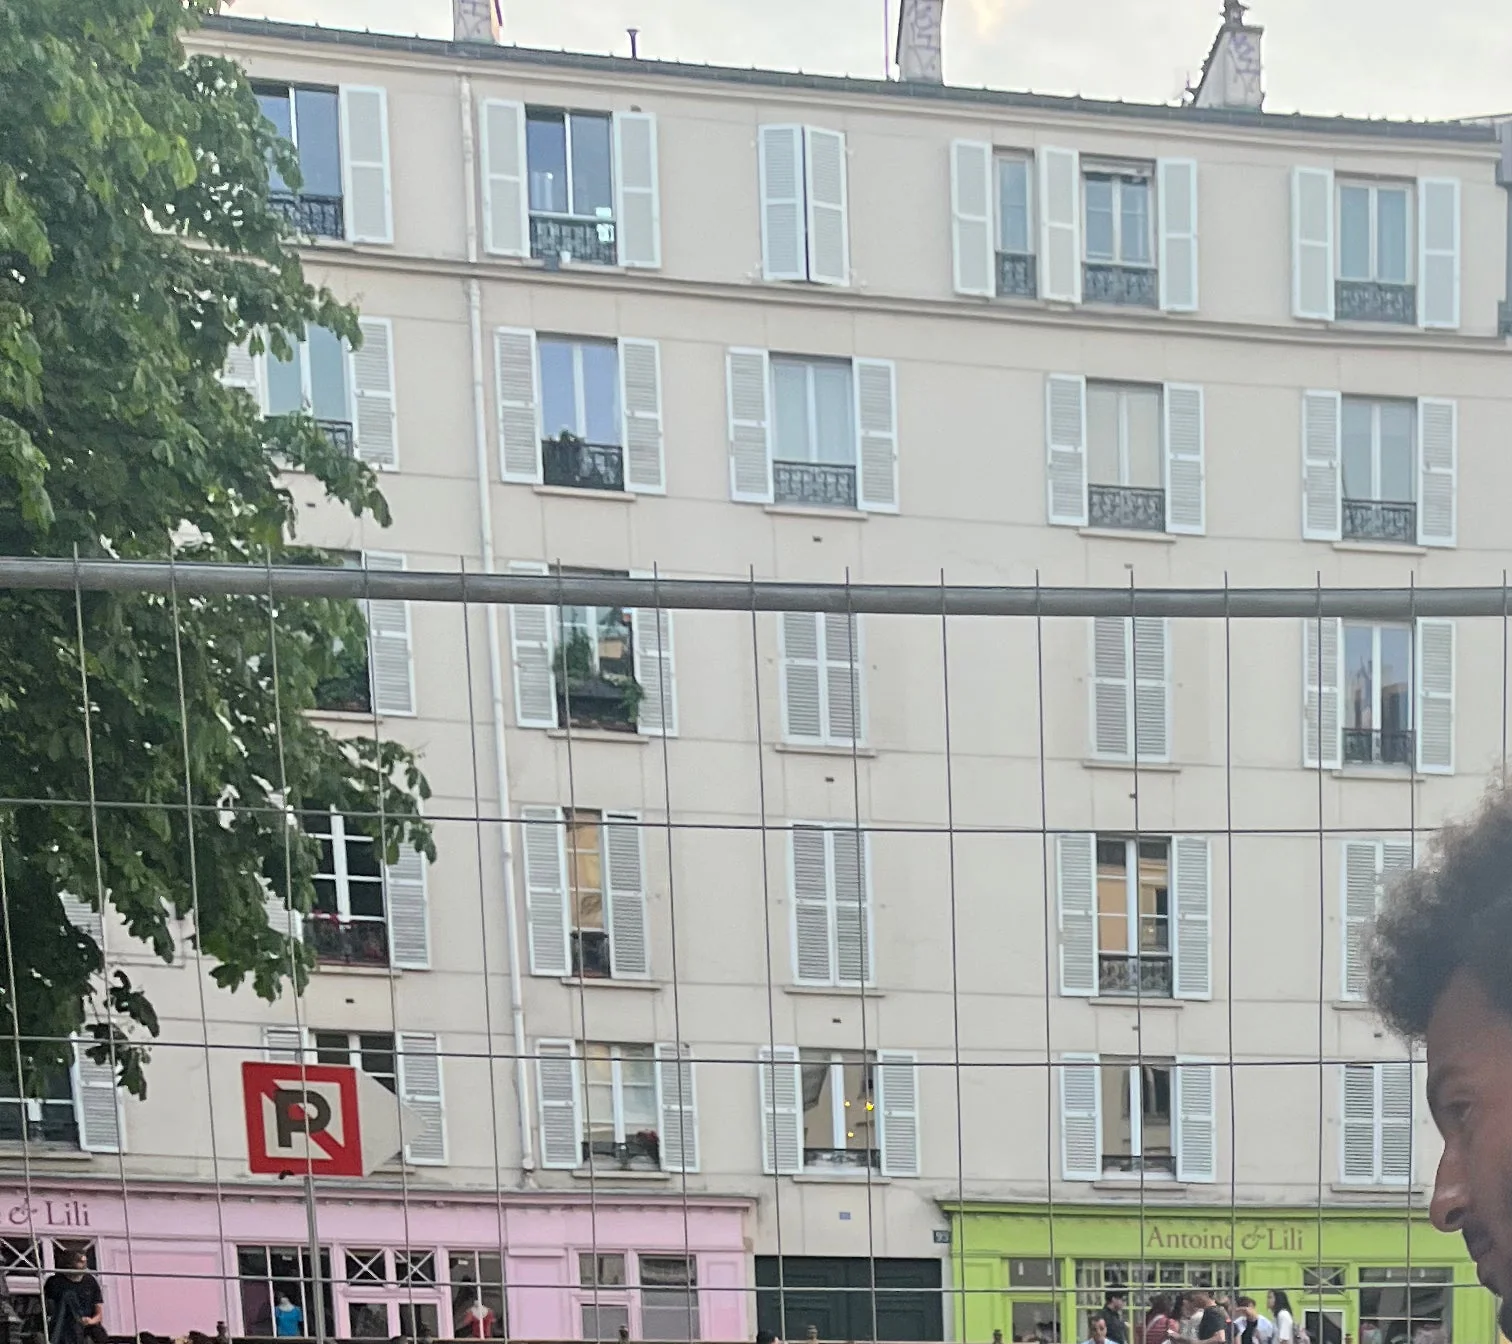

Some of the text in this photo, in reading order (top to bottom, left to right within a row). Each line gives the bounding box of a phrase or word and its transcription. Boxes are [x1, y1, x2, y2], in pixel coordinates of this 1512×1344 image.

[46, 1201, 90, 1226] Lili
[1147, 1226, 1232, 1250] Antoine
[1267, 1228, 1304, 1251] Lili
